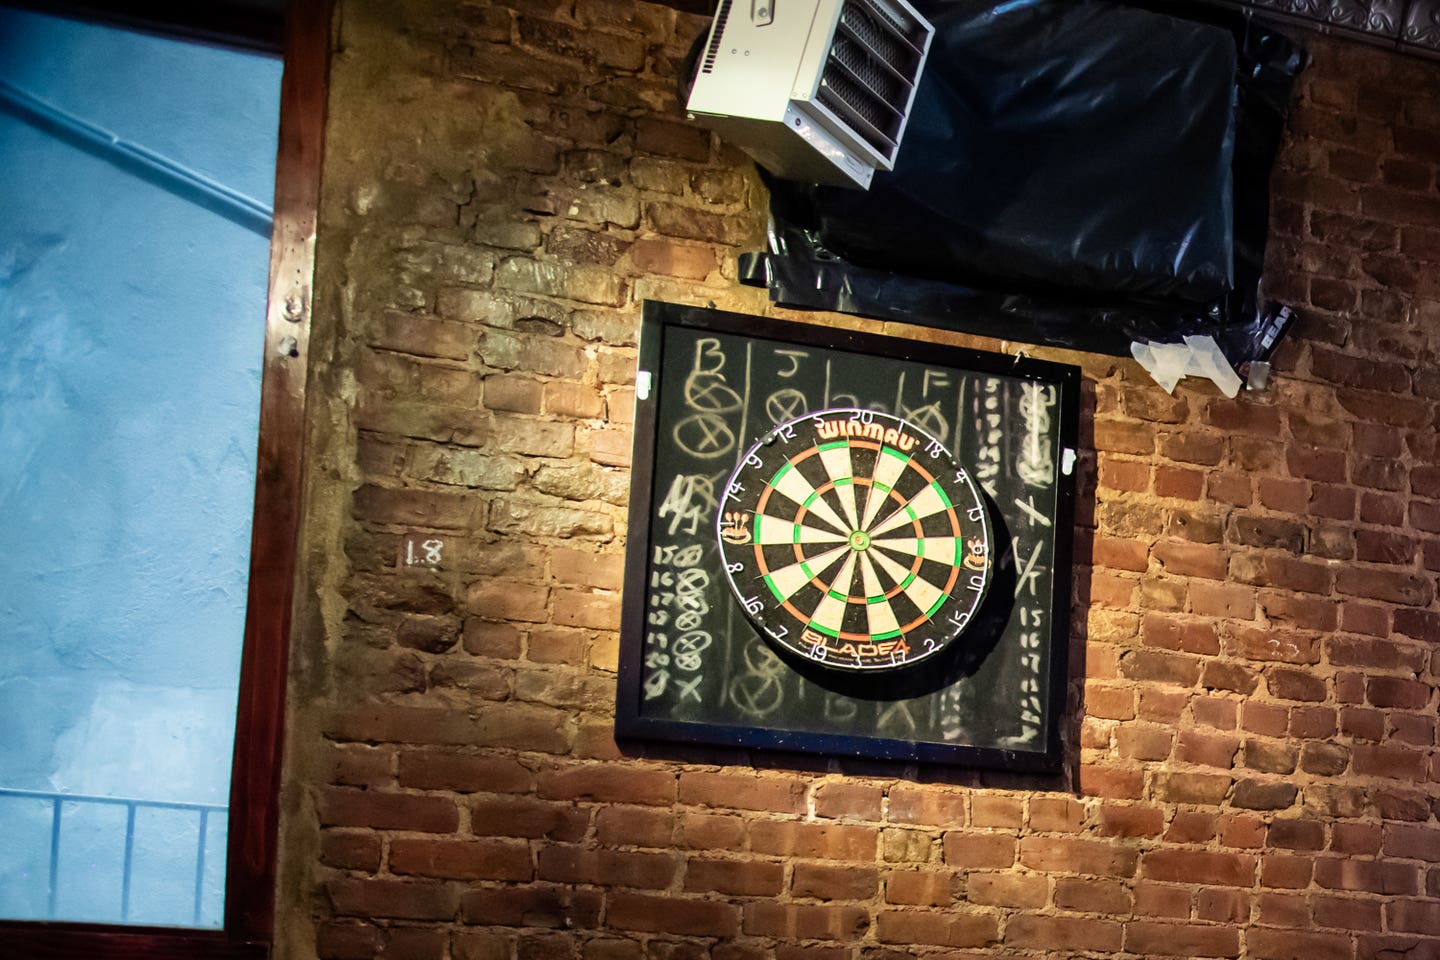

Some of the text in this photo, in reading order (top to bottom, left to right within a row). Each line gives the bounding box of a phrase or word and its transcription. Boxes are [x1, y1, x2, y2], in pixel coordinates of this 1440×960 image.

[1261, 306, 1292, 349] BEAR
[696, 338, 726, 381] B
[774, 350, 809, 377] J
[923, 369, 949, 397] F
[813, 415, 826, 429] 5
[850, 410, 874, 425] 20
[778, 425, 798, 444] 12
[818, 420, 915, 451] WINMAU
[925, 439, 944, 459] 18
[746, 453, 763, 469] 9
[953, 467, 967, 484] 4
[728, 482, 746, 502] 14
[728, 562, 744, 574] 8
[651, 571, 675, 588] 16
[966, 575, 985, 592] 10
[745, 596, 765, 615] 16
[949, 610, 970, 628] 15
[1020, 606, 1044, 627] 15
[774, 624, 789, 640] 7
[810, 643, 828, 661] 19
[924, 638, 936, 653] 2
[850, 652, 862, 668] 3
[890, 649, 906, 667] 17
